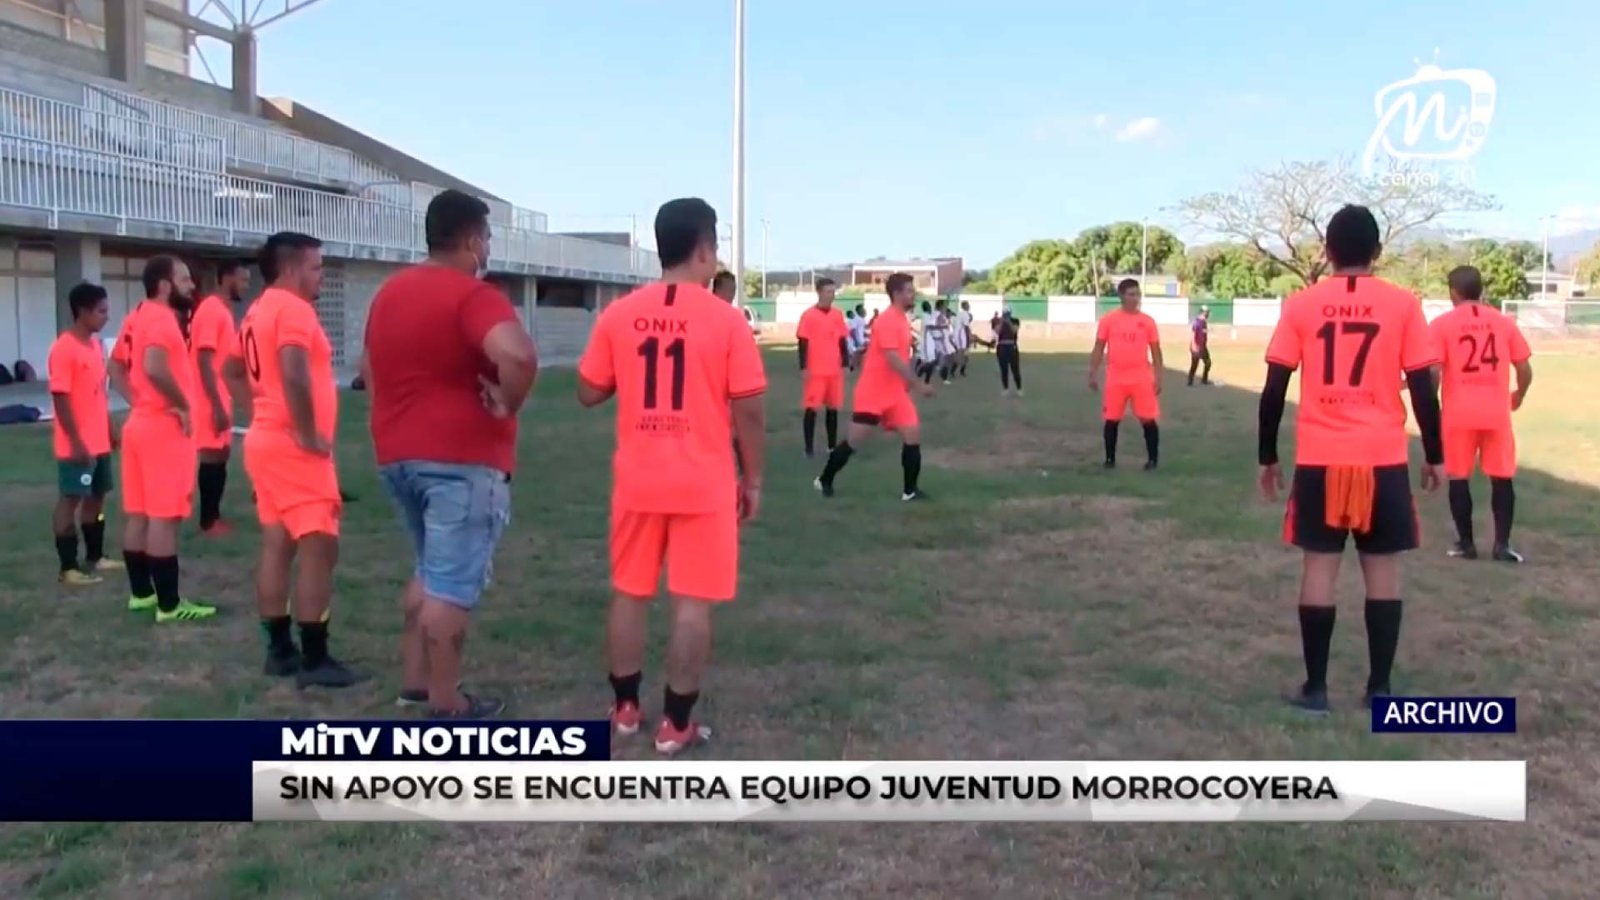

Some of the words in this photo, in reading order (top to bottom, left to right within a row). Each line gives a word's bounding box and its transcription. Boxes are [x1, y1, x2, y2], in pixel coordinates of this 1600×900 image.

[633, 317, 690, 334] ONIX
[1322, 304, 1373, 318] ONIX
[1316, 321, 1381, 387] 17
[1458, 332, 1500, 373] 24
[637, 336, 686, 411] 11
